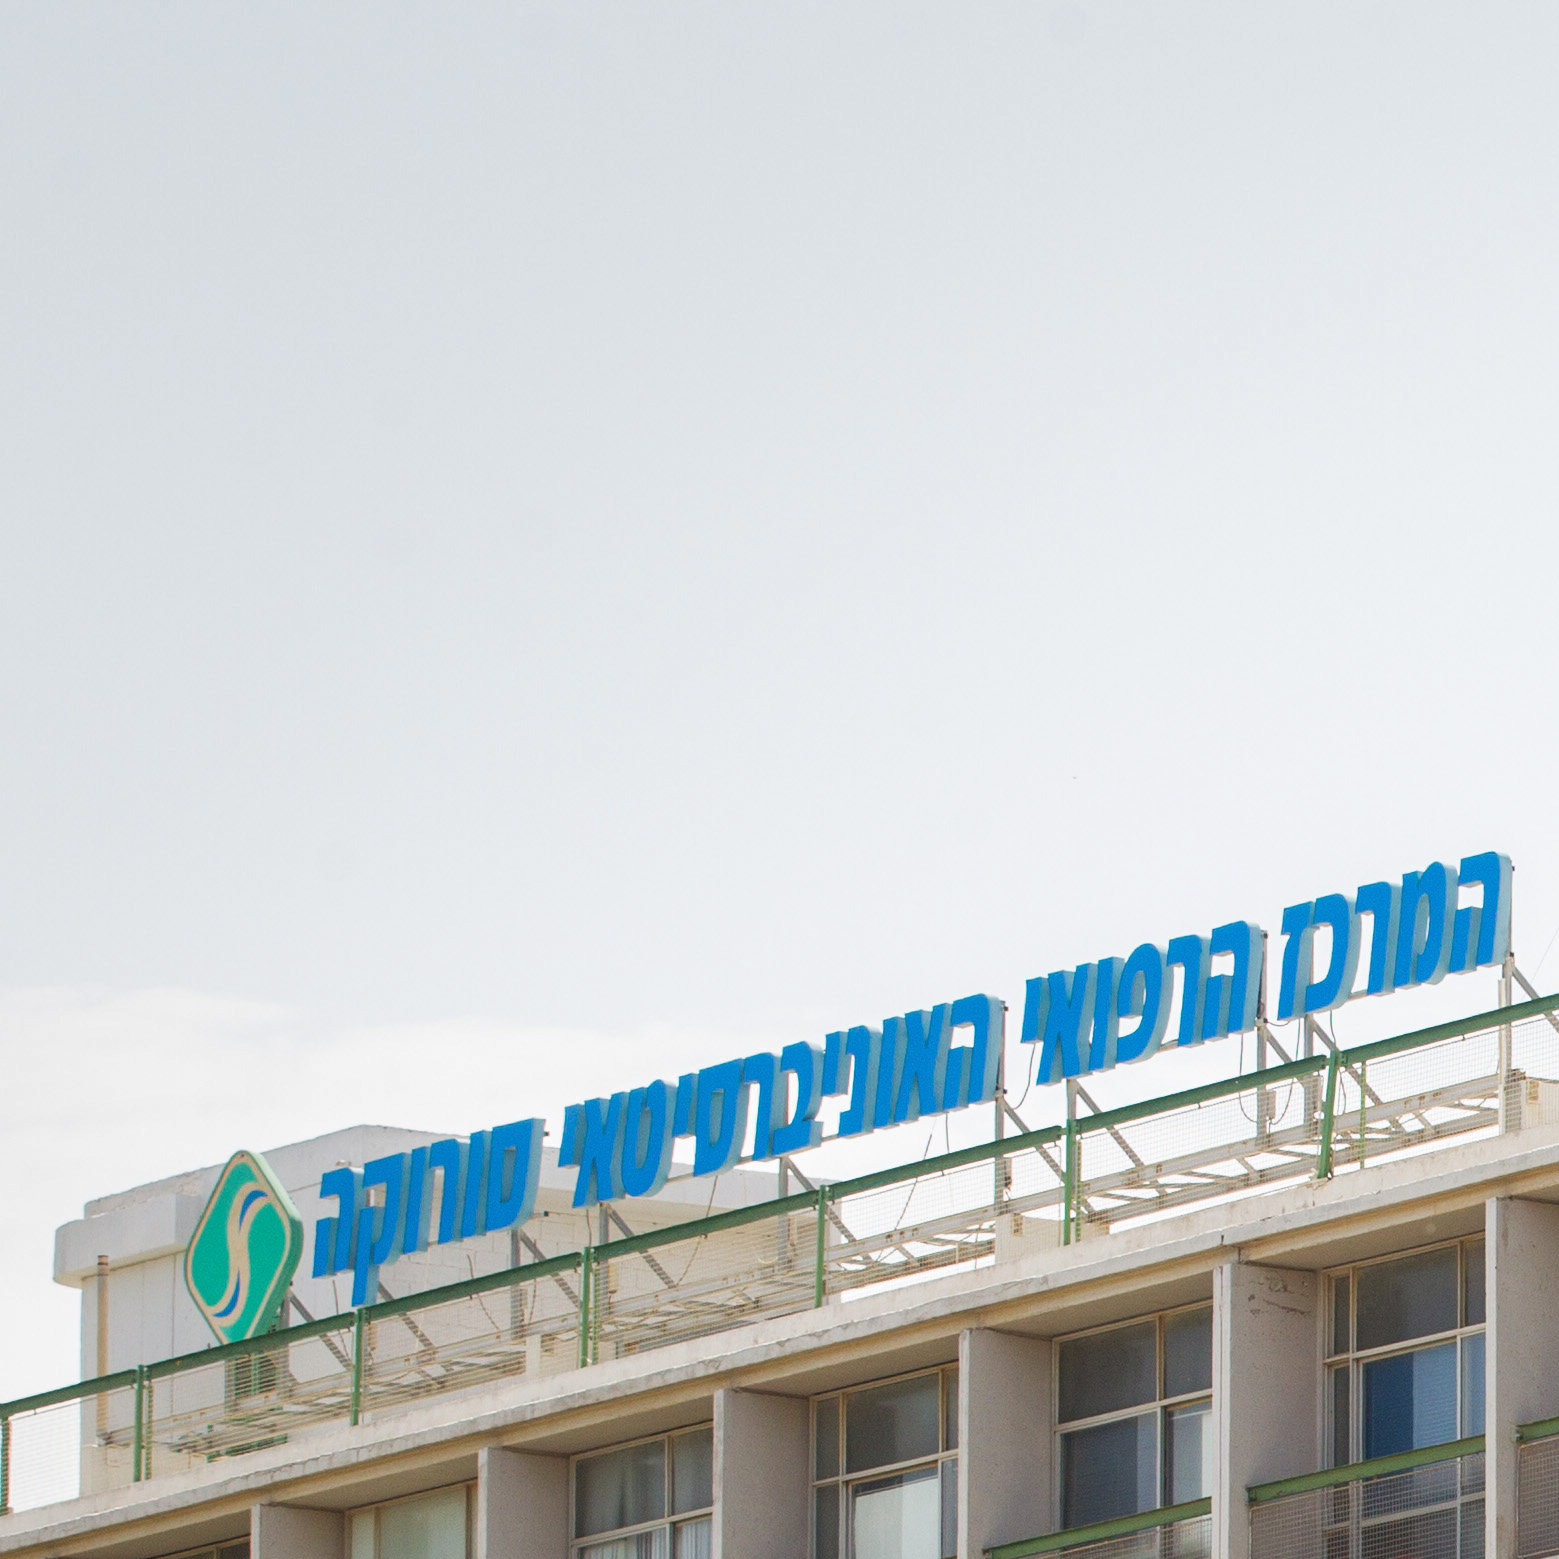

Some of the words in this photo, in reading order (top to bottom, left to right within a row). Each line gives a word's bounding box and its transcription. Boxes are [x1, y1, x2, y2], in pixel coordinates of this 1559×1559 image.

[1021, 920, 1259, 1086] הרפואי
[1277, 850, 1508, 1021] המרכז
[558, 993, 998, 1209] האוניברסיטאי
[312, 1118, 541, 1307] סורוקה
